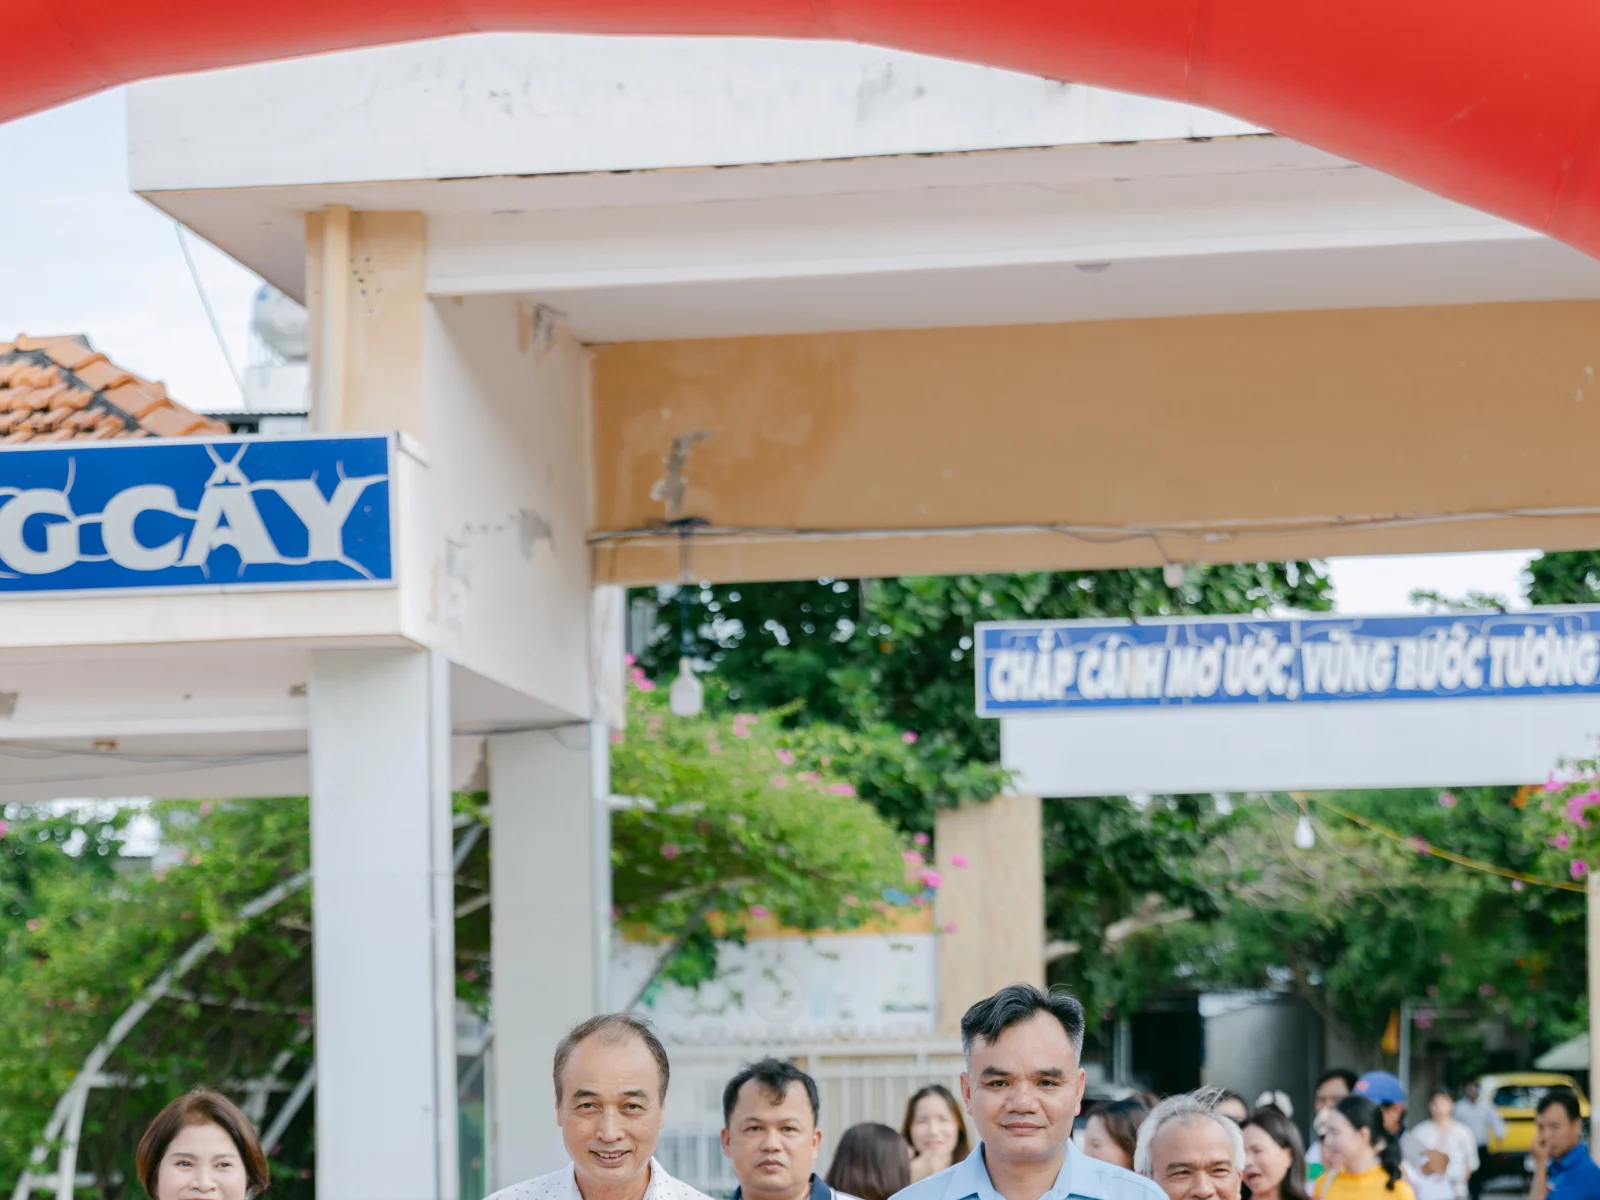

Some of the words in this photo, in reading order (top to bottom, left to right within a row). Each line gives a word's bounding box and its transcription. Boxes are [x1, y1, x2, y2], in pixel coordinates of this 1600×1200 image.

[1078, 634, 1165, 699] CÁNH
[1165, 635, 1225, 697] MƠ
[1396, 622, 1485, 690] BƯỚC
[1488, 626, 1598, 688] TƯƠNG
